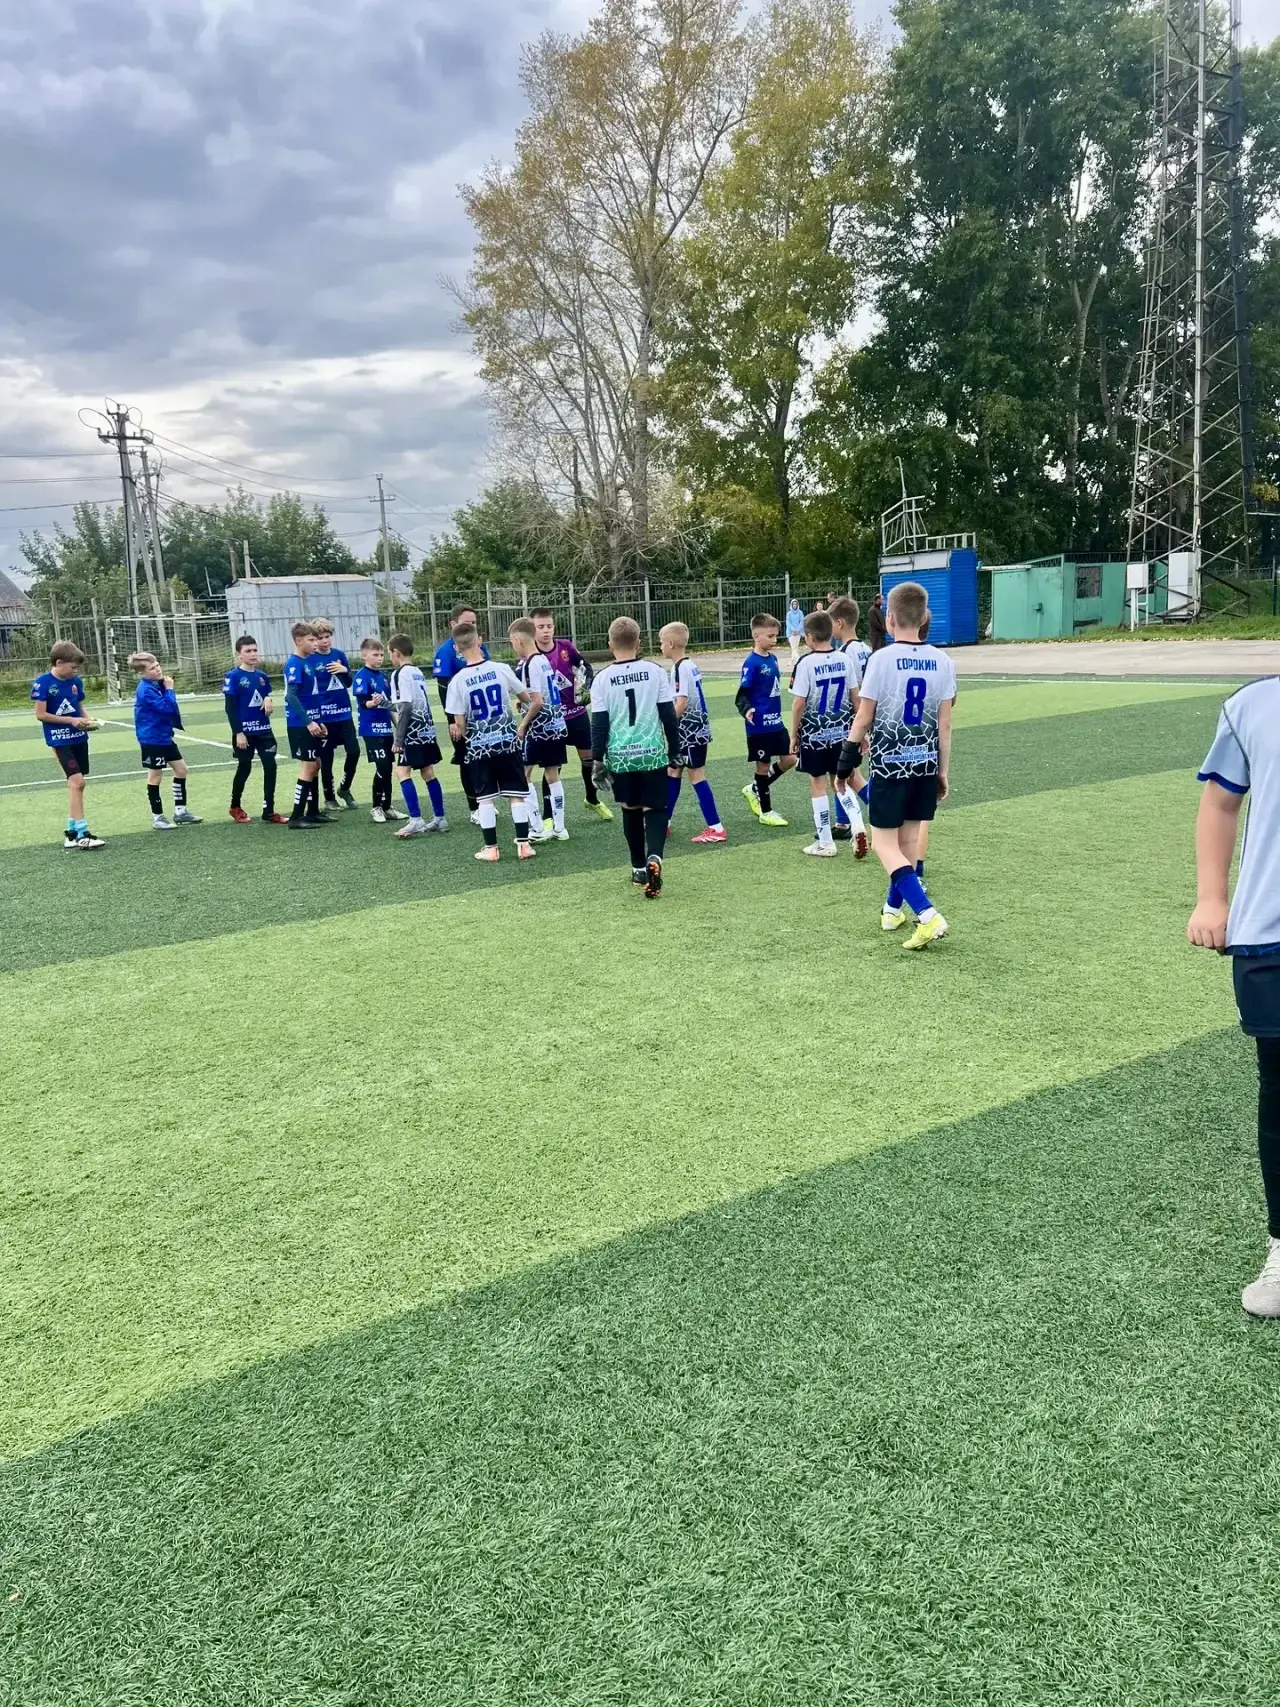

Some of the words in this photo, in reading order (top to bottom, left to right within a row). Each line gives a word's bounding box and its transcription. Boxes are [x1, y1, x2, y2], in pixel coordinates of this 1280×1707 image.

[896, 658, 937, 671] СОРОКИН
[465, 670, 497, 687] КАГАНОВ
[610, 671, 649, 686] МЕЗЕНЦЕВ
[469, 683, 503, 721] 99
[815, 676, 846, 717] 77
[903, 677, 927, 725] 8
[625, 688, 637, 727] 1
[321, 739, 328, 748] 7
[373, 749, 386, 760] 13
[757, 749, 766, 760] 9
